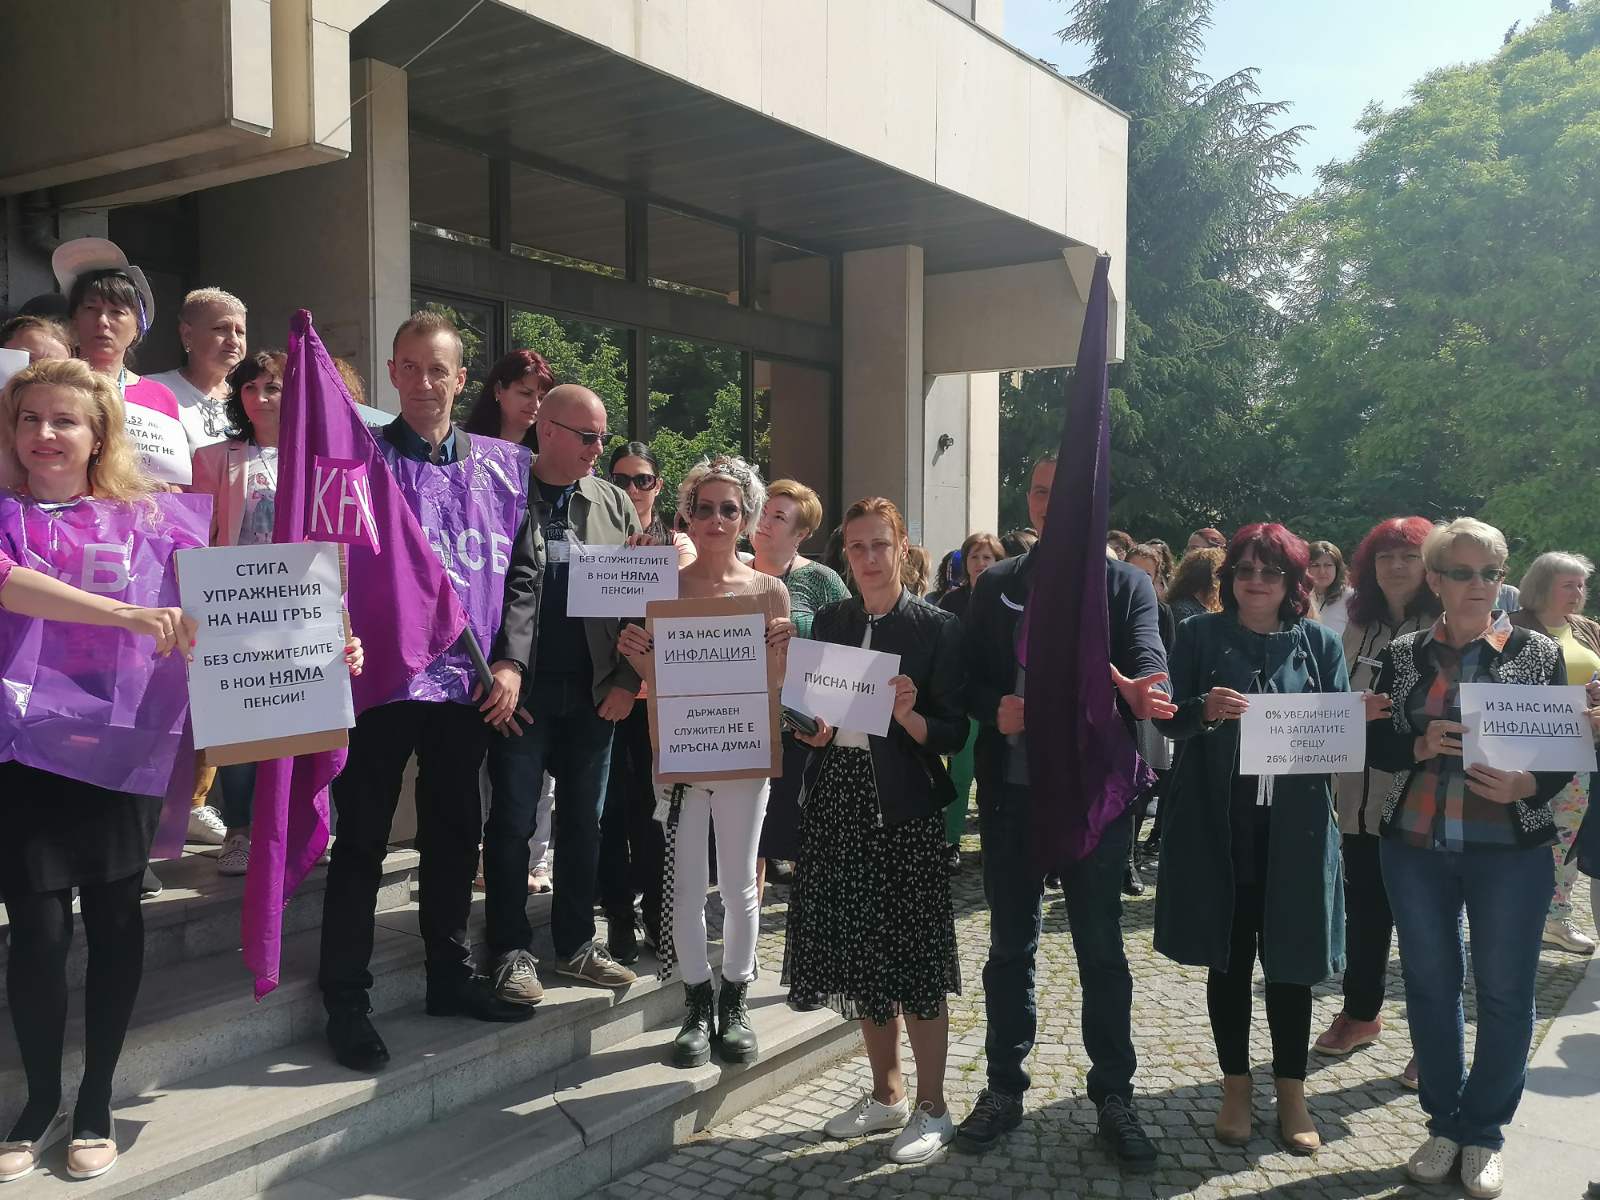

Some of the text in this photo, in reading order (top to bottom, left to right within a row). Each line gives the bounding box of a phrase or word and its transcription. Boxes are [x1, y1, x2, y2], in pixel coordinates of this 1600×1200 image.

[135, 442, 175, 456] ЛИСТ НЕ
[579, 555, 669, 566] БЕЗ СЛУЖИТЕЛИТЕ
[236, 561, 289, 577] СТИГА
[587, 571, 660, 583] В НОИ НЯМА
[203, 583, 322, 603] УПРАЖНЕНИЯ
[601, 586, 644, 595] ПЕНСИИ!
[208, 606, 322, 627] НА НАШ ГРЪБ
[667, 628, 752, 640] И ЗА НАС ИМА
[203, 642, 333, 667] БЕЗ СЛУЖИТЕЛИТЕ
[664, 646, 757, 663] ИНФЛАЦИЯ!
[220, 666, 324, 690] В НОИ НЯМА
[804, 672, 876, 695] ПИСНА НИ!
[243, 690, 305, 709] ПЕНСИИ!
[686, 707, 740, 719] ДЪРЖАВЕН
[1485, 701, 1574, 714] И ЗА НАС ИМА
[1265, 709, 1351, 720] 0% УВЕЛИЧЕНИЕ
[674, 722, 755, 736] СЛУЖИТЕЛ НЕ Е
[1270, 725, 1346, 735] НА ЗАПЛАТИТЕ
[1482, 720, 1582, 737] ИНФЛАЦИЯ!
[669, 740, 761, 753] МРЪСНА ДУМА!
[1290, 739, 1326, 750] СРЕЩУ
[1266, 754, 1348, 764] 26% ИНФЛАЦИЯ
